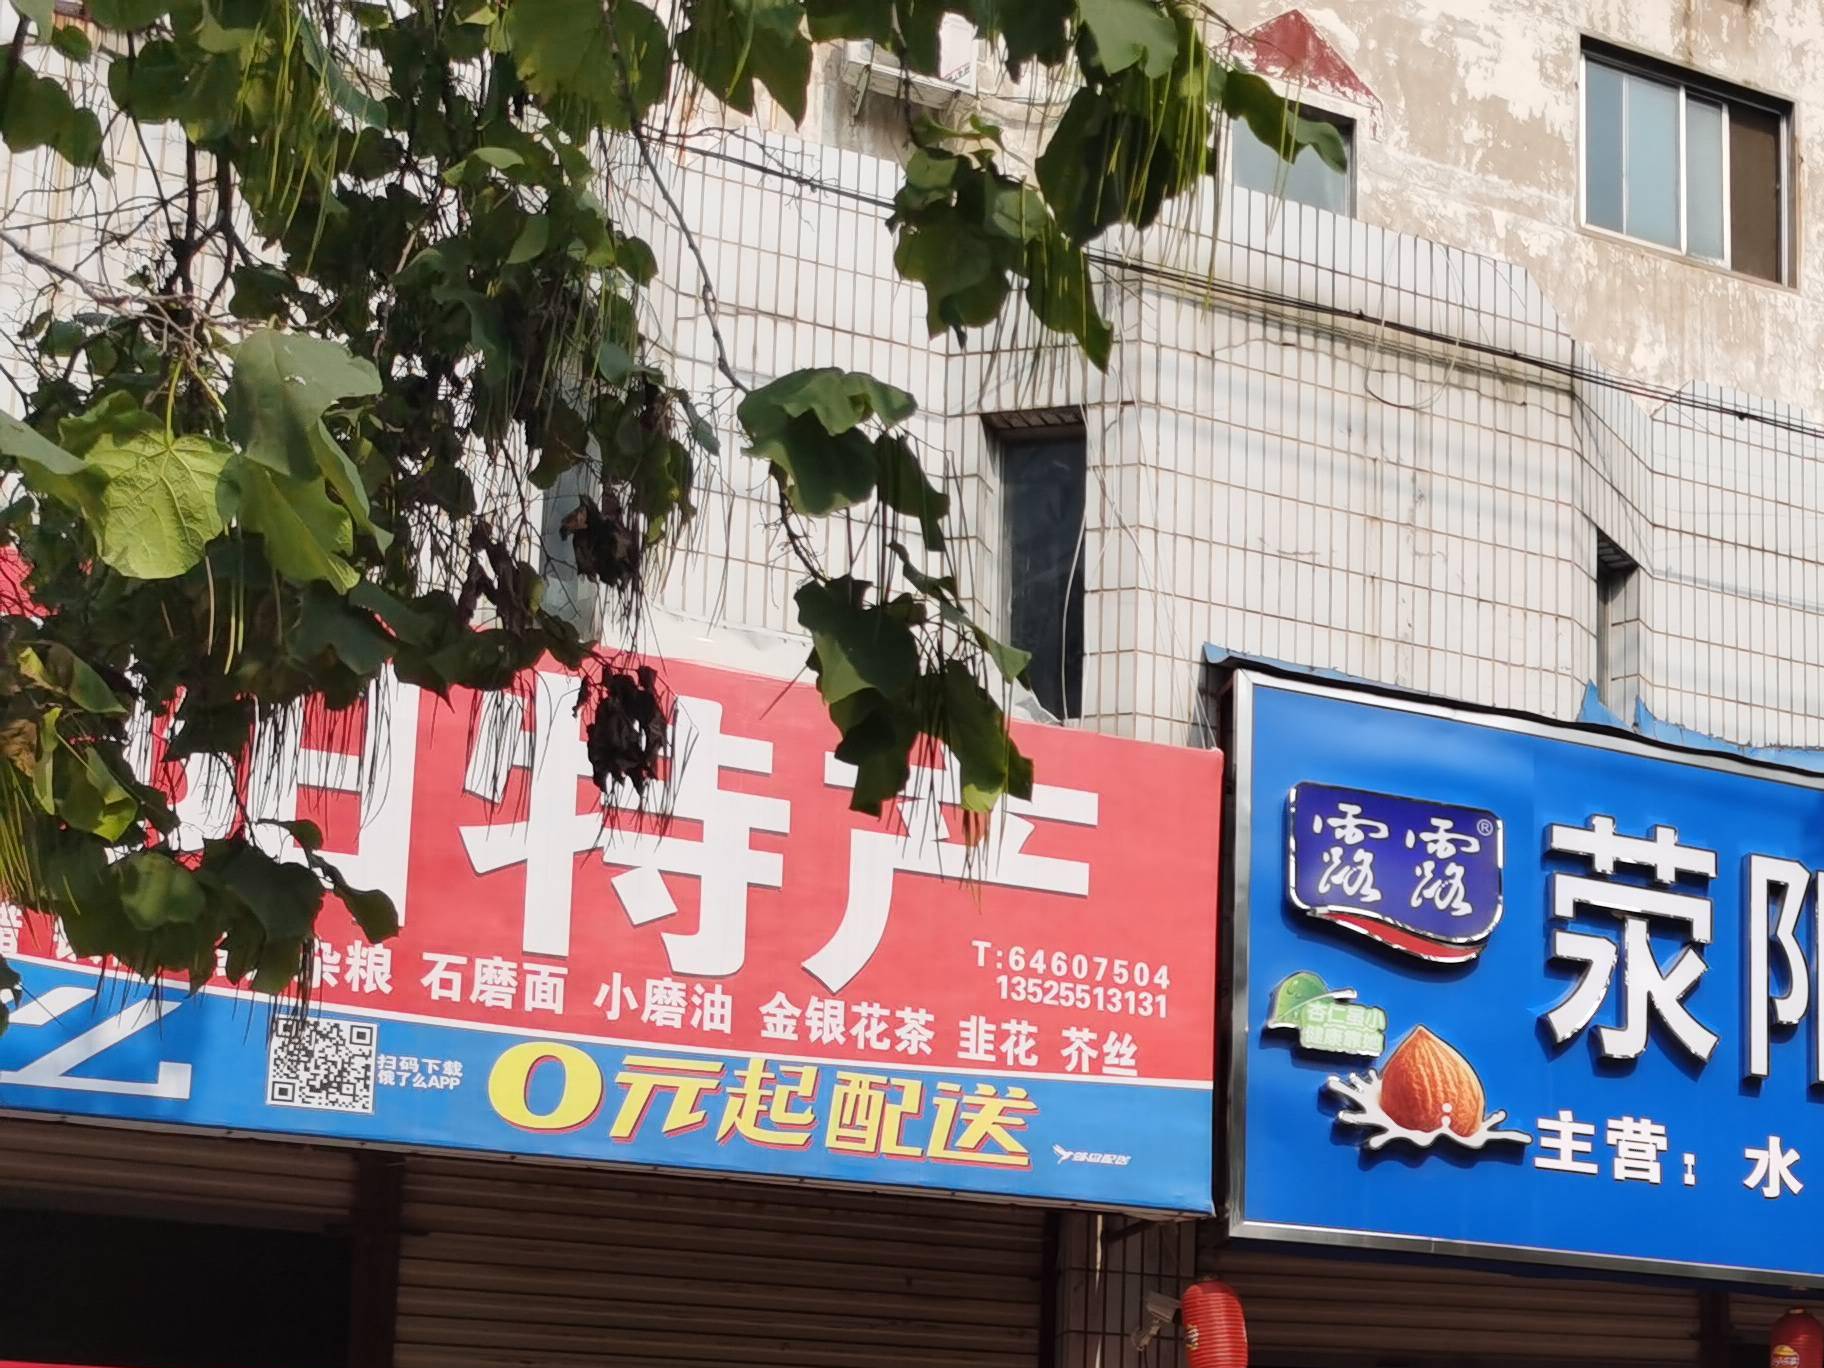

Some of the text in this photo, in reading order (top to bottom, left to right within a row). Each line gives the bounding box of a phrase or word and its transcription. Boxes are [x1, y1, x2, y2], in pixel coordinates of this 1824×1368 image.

[971, 938, 1171, 989] T:64607504
[420, 951, 568, 1015] 石磨面
[595, 972, 733, 1034] 小磨油
[759, 991, 935, 1056] 金银花茶
[957, 1014, 1040, 1067] 韭花
[1060, 1027, 1140, 1079] 芥丝
[996, 973, 1168, 1019] 13525513131
[1742, 1135, 1804, 1200] 水
